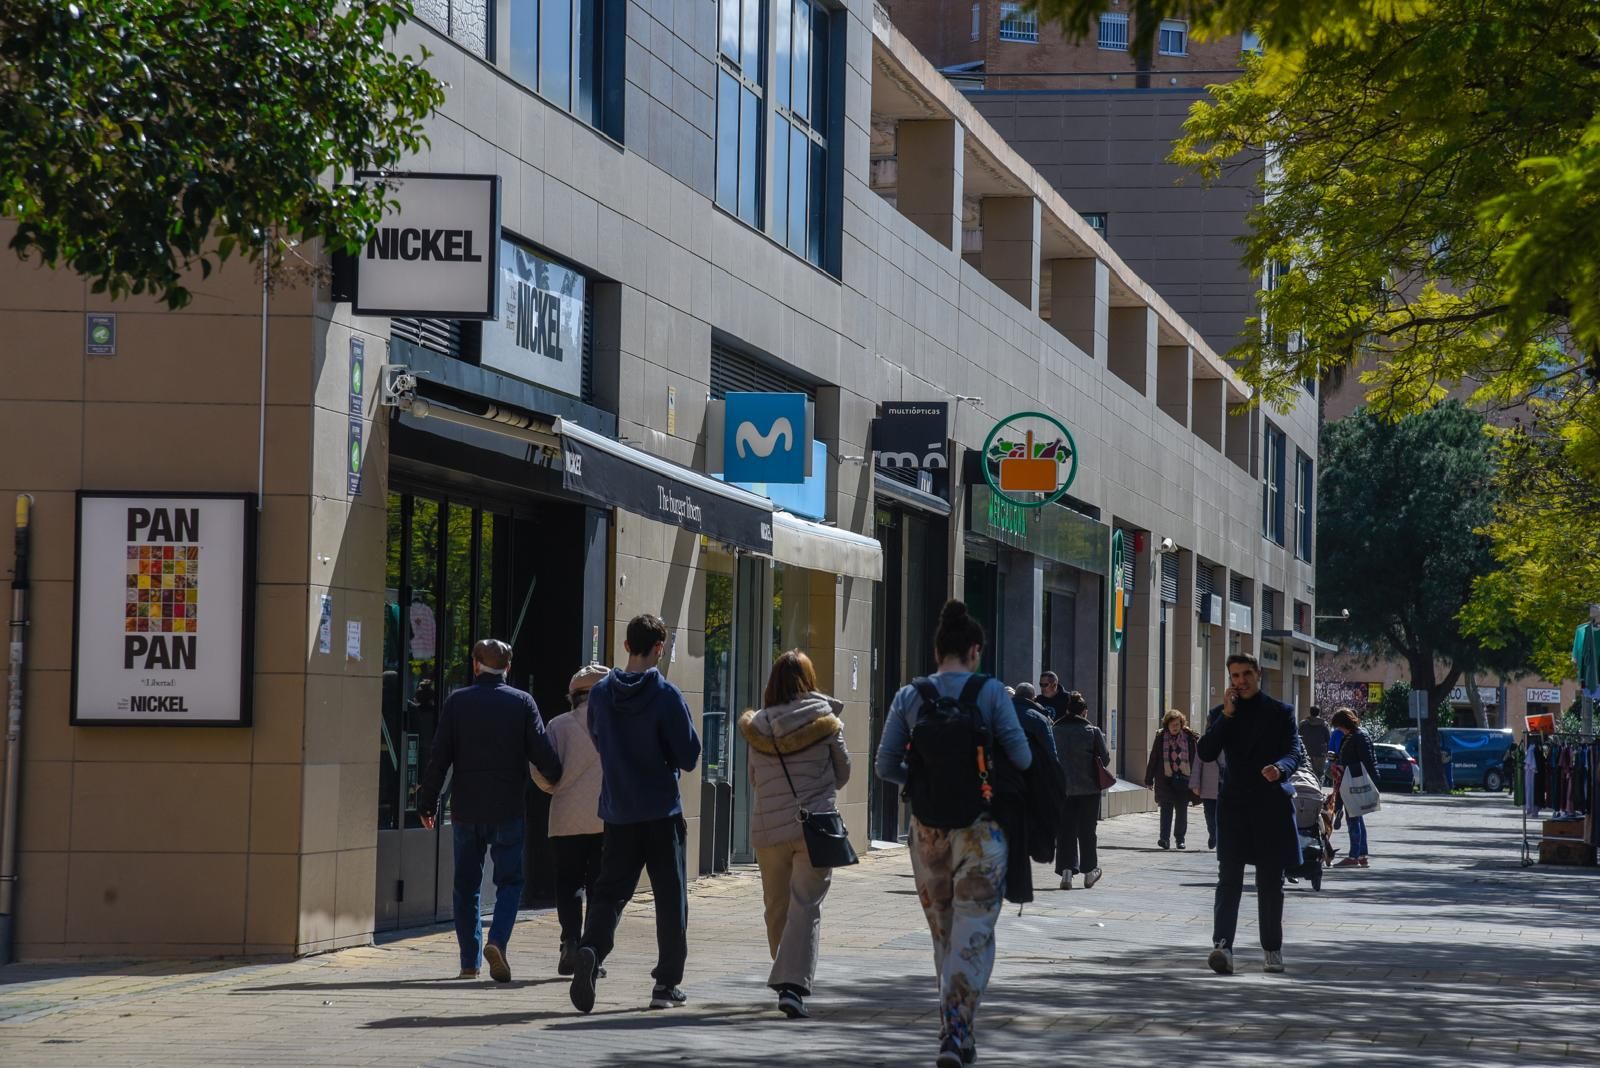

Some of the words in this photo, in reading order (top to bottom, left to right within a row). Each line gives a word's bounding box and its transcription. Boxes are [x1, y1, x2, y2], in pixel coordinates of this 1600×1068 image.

[366, 228, 482, 262] NICKEL
[516, 280, 563, 362] NICKEL
[657, 485, 669, 511] The
[669, 489, 686, 523] burger
[127, 507, 199, 542] PAN
[124, 635, 196, 669] PAN
[130, 696, 188, 712] NICKEL
